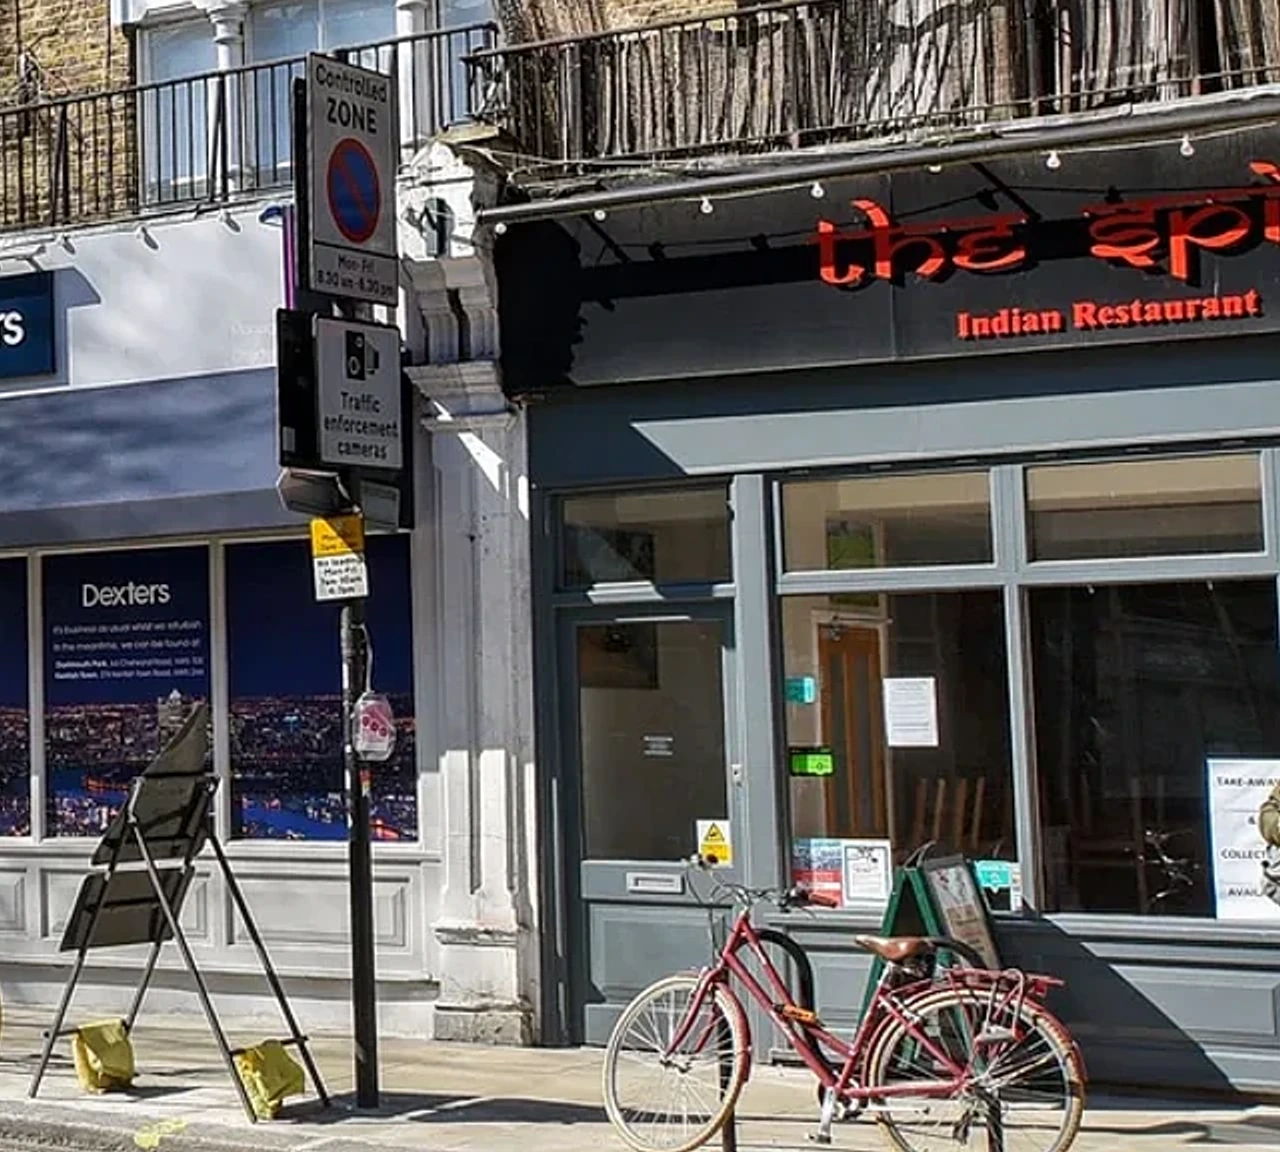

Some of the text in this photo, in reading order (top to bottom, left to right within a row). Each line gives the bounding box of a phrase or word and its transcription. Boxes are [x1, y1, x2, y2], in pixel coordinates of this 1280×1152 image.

[316, 64, 387, 103] Controlled
[327, 96, 377, 135] ZONE
[807, 198, 1029, 285] the
[956, 288, 1260, 338] Indian Restaurant
[340, 391, 380, 414] Traffic
[324, 414, 399, 439] enforcement
[337, 441, 388, 461] cameras
[81, 581, 171, 608] Dexters
[1247, 815, 1257, 826] &
